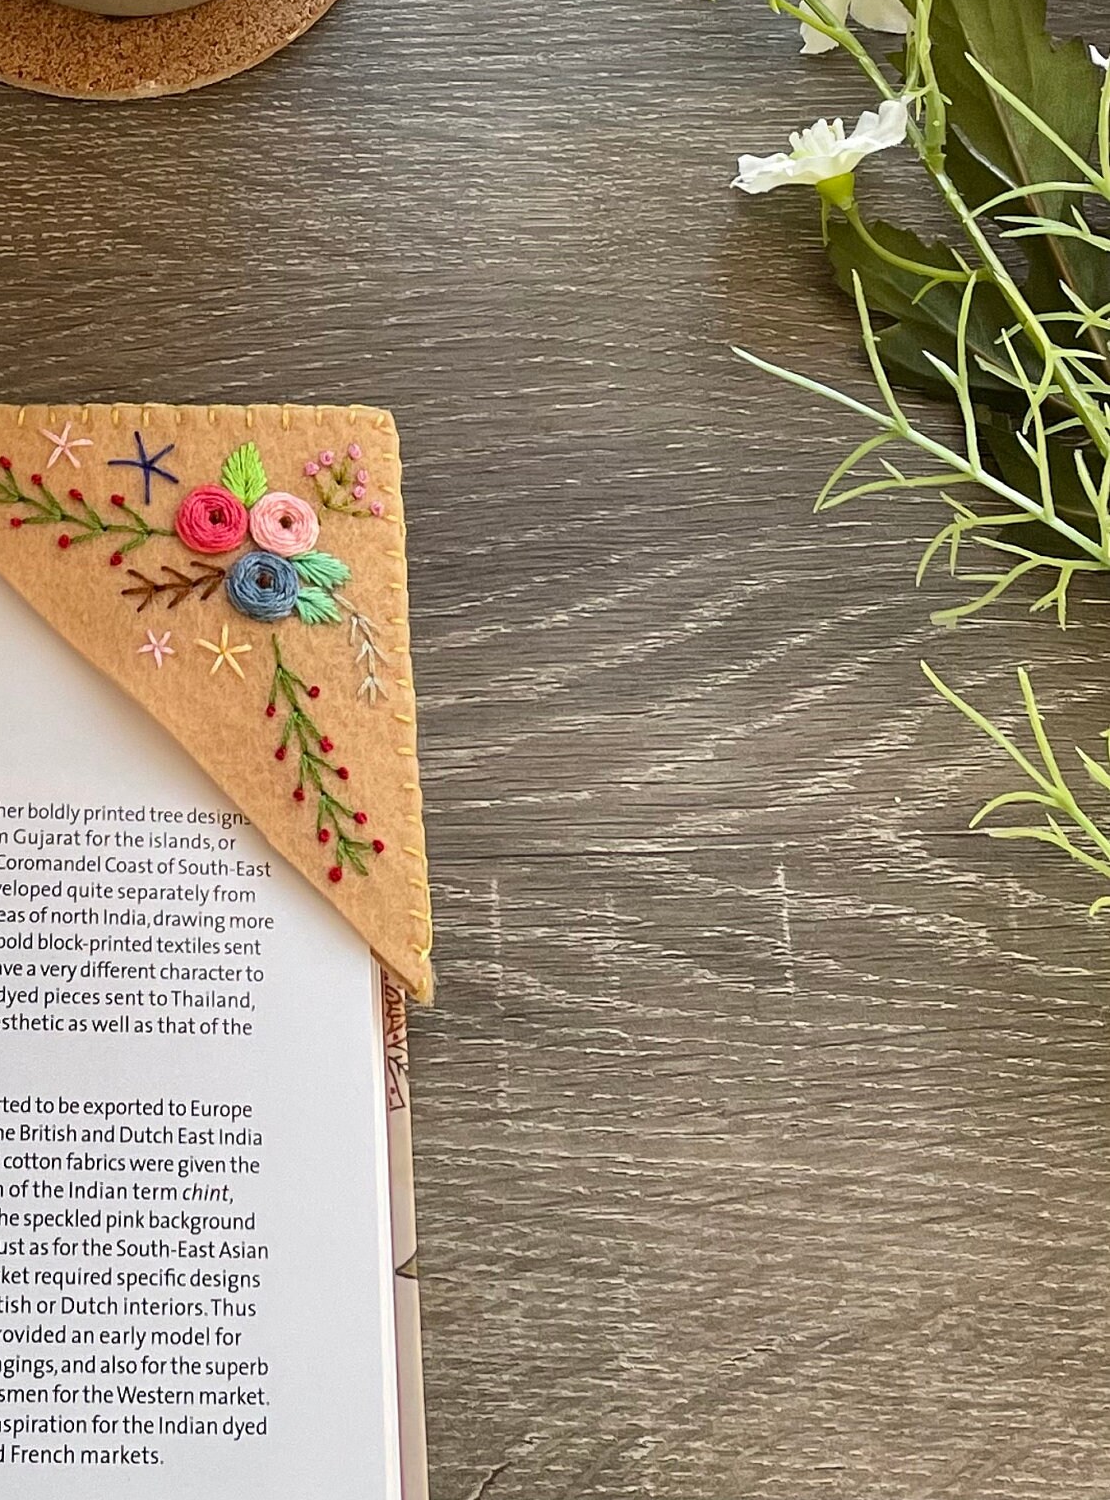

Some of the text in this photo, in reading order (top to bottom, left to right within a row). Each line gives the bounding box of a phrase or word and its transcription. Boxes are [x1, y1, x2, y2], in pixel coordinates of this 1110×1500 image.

[104, 856, 154, 875] Coast
[156, 857, 176, 875] of
[178, 857, 272, 879] South-East
[37, 932, 153, 957] block-printed
[155, 936, 221, 955] textiles
[224, 939, 262, 956] sent
[43, 987, 101, 1010] pieces
[104, 989, 145, 1007] sent
[148, 989, 168, 1007] to
[170, 989, 256, 1012] Thailand,
[34, 1096, 55, 1114] to
[58, 1095, 80, 1115] be
[82, 1097, 164, 1121] exported
[167, 1098, 187, 1117] to
[190, 1099, 253, 1124] Europe
[36, 1299, 57, 1315] or
[61, 1295, 118, 1316] Dutch
[123, 1296, 209, 1317] interiors.
[210, 1297, 257, 1317] Thus
[91, 1414, 120, 1435] for
[121, 1414, 155, 1435] the
[159, 1414, 218, 1436] Indian
[222, 1415, 267, 1442] dyed
[10, 1443, 75, 1464] French
[80, 1444, 164, 1465] markets.
